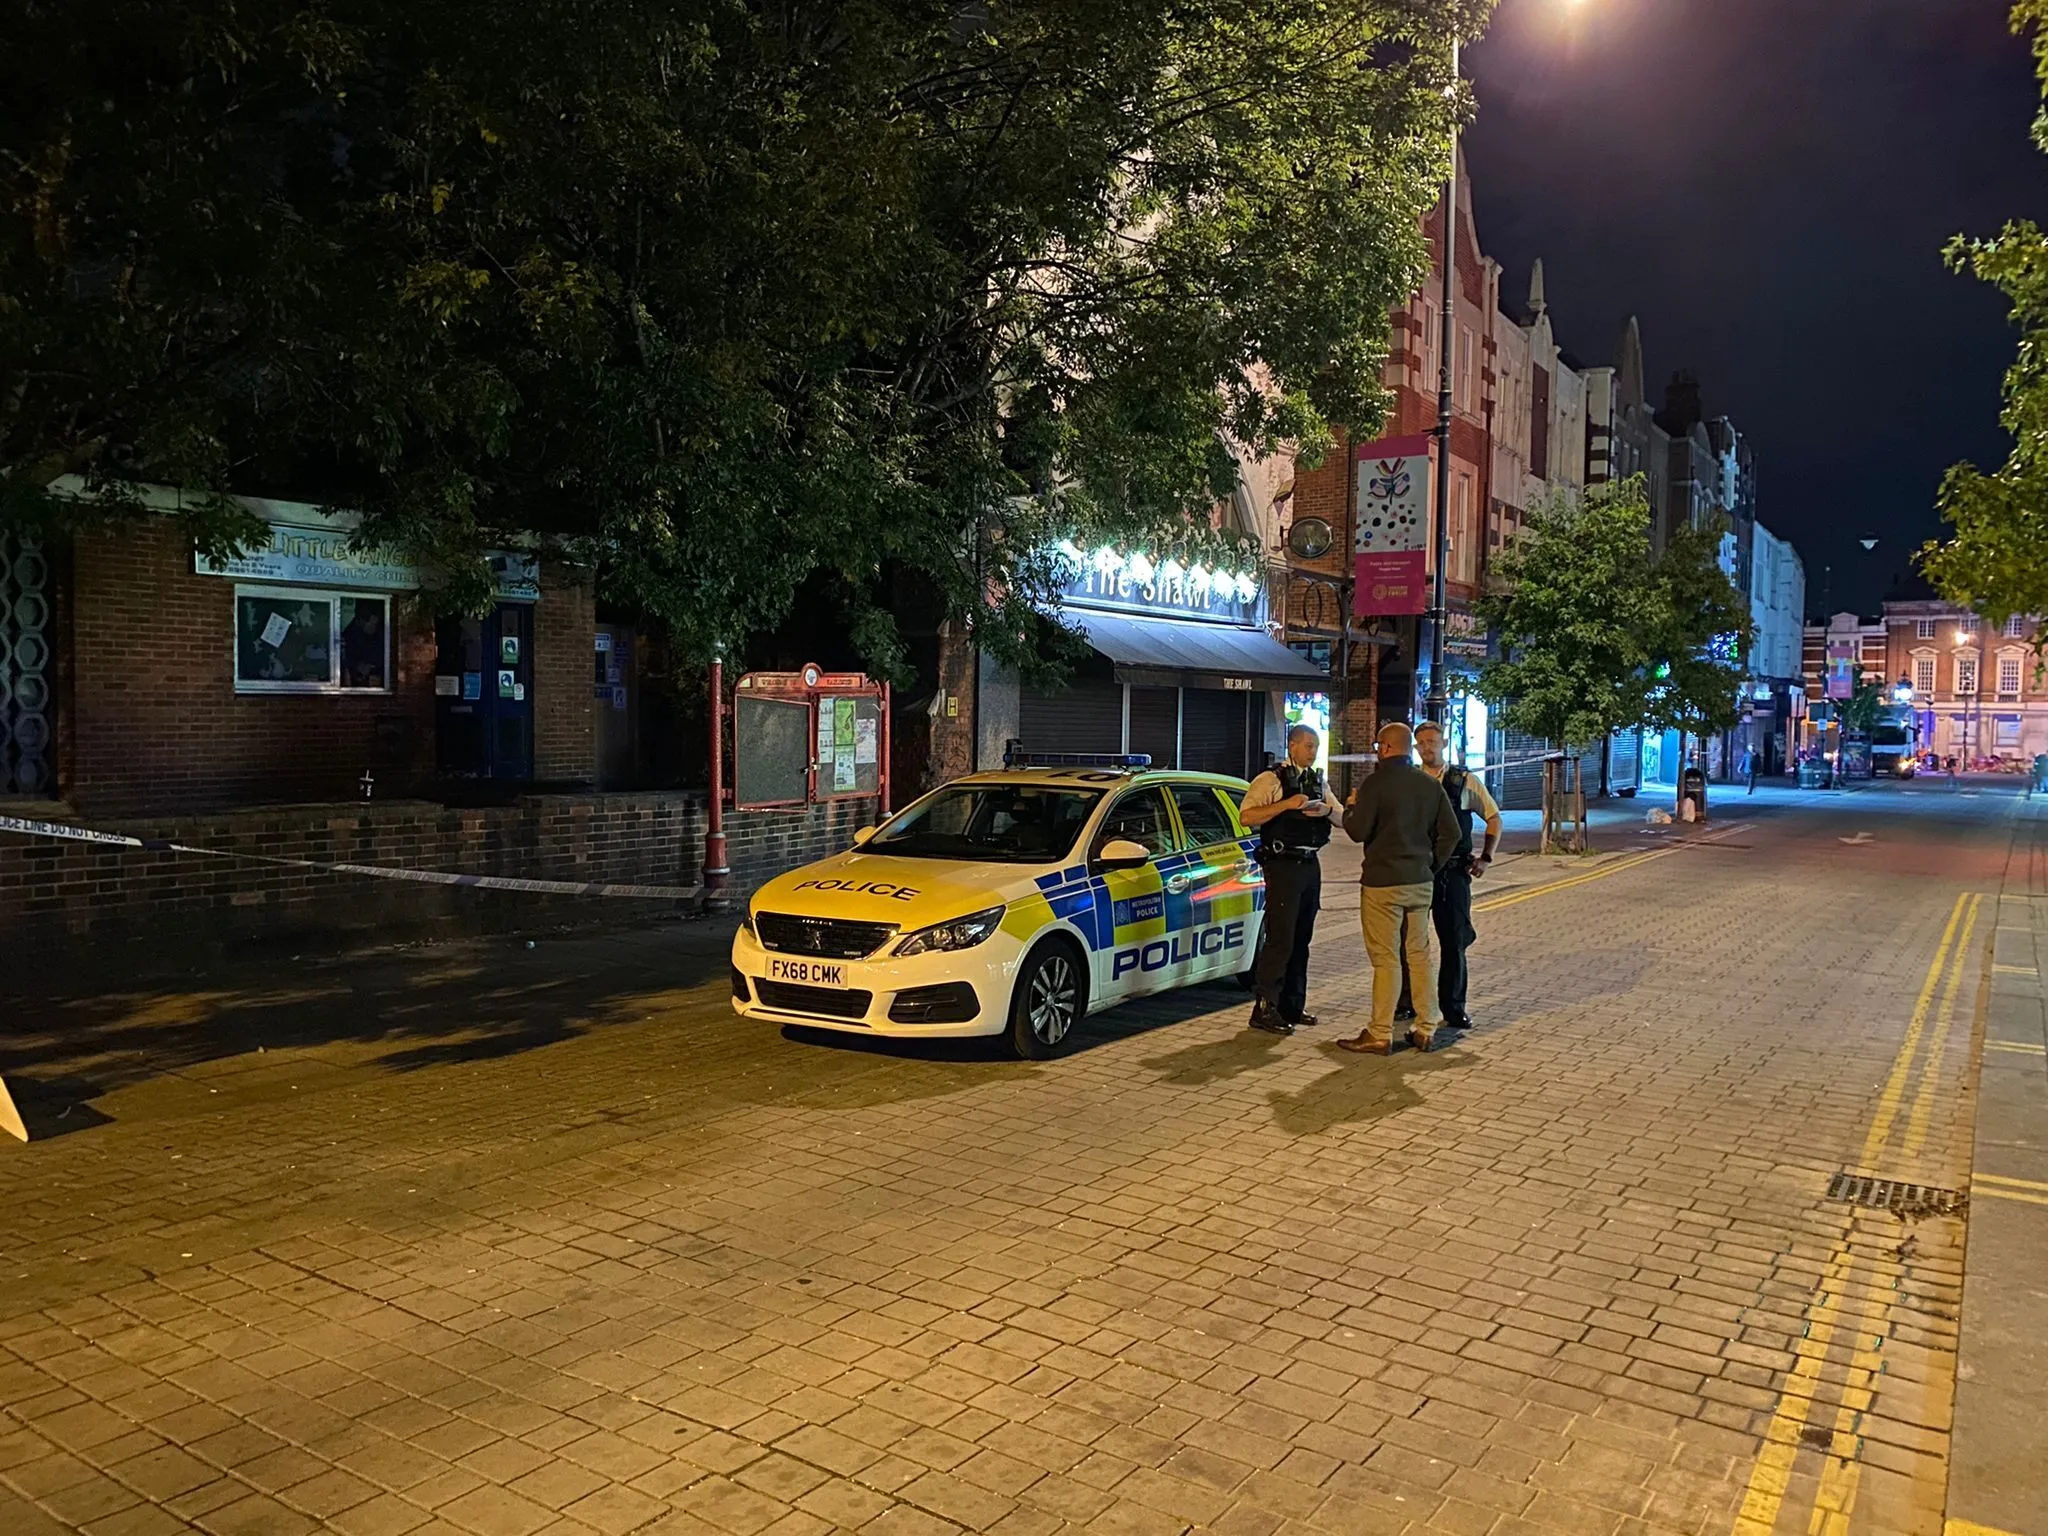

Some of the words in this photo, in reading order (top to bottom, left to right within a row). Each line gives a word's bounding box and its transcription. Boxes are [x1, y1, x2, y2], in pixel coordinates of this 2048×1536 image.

[268, 533, 346, 562] LITTLE
[1223, 678, 1234, 689] THE
[1235, 679, 1253, 690] SHAWL
[24, 820, 47, 833] LINE
[50, 824, 66, 835] DO
[69, 826, 89, 838] NOT
[792, 879, 922, 902] POLICE
[1136, 906, 1159, 918] POLICE
[1112, 921, 1244, 981] POLICE
[772, 960, 808, 981] FX68
[812, 964, 842, 984] CMK
